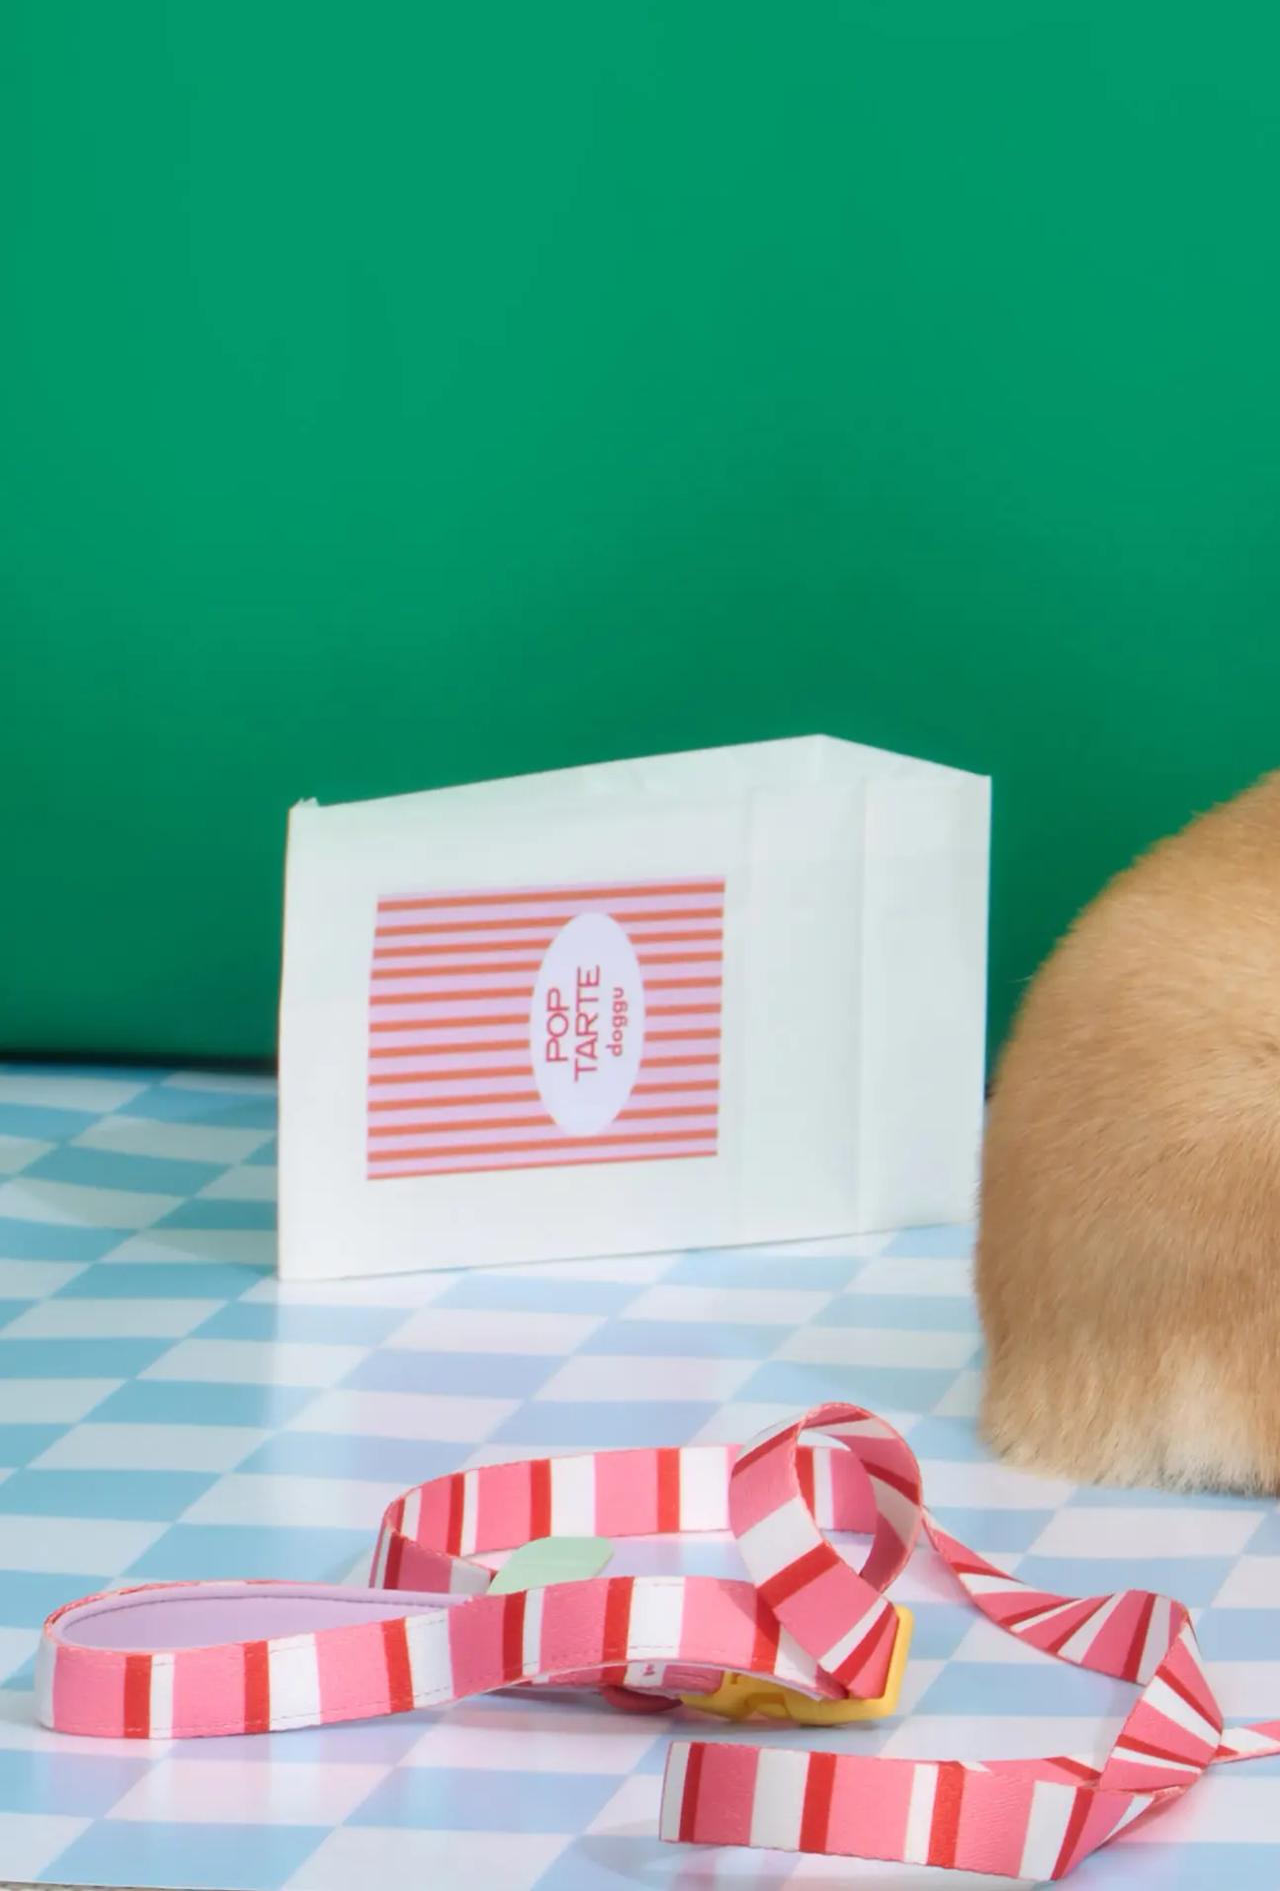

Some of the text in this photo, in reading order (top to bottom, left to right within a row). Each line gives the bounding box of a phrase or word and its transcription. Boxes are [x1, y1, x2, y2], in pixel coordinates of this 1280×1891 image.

[545, 987, 570, 1063] POP
[573, 964, 601, 1082] TARTE
[606, 986, 628, 1057] doggu
